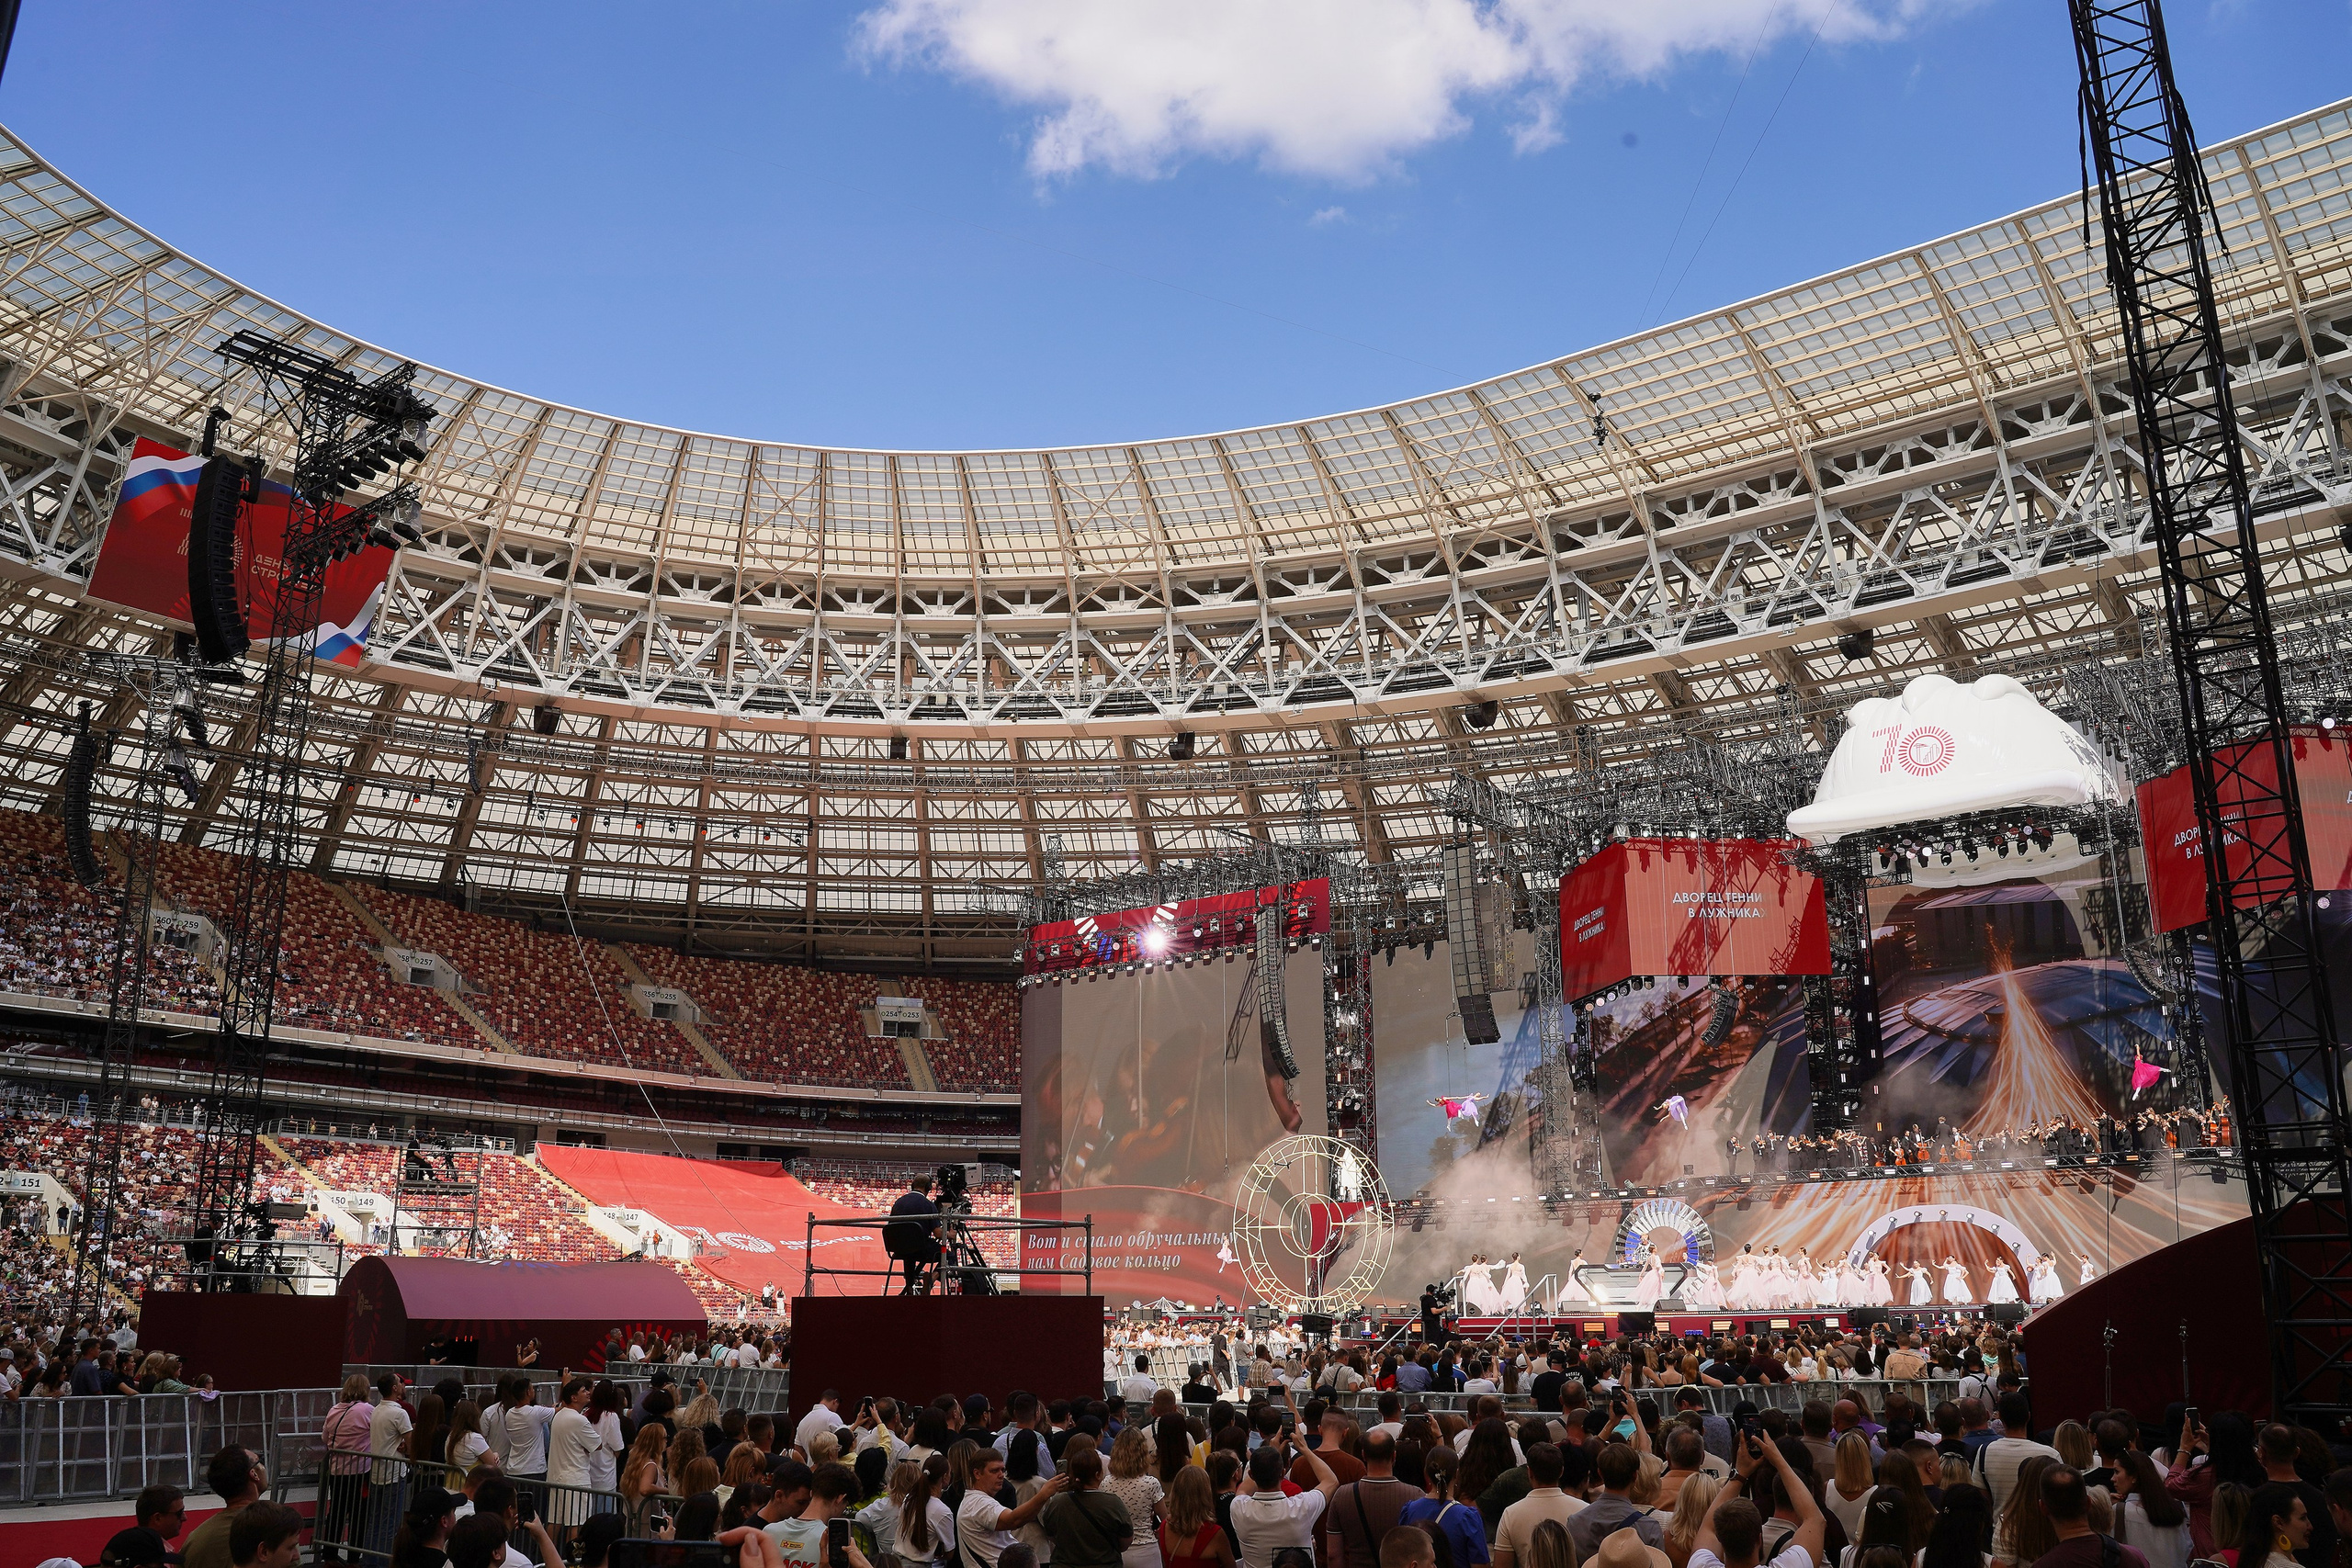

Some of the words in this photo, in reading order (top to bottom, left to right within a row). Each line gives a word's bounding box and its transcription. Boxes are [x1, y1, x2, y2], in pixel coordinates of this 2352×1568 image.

[2186, 848, 2192, 859] В
[1672, 892, 1724, 904] ДВОРЕЦ
[1688, 908, 1696, 918] В
[184, 919, 198, 930] 259
[1574, 912, 1591, 931] ДВОРЕЦ
[1578, 933, 1583, 942] В
[420, 958, 433, 966] 257
[643, 990, 656, 998] 256
[21, 1178, 40, 1188] 151
[358, 1198, 375, 1206] 149
[1028, 1234, 1057, 1249] Вот
[1061, 1236, 1070, 1248] и
[1074, 1235, 1123, 1248] стало
[1027, 1257, 1055, 1269] нам
[1059, 1252, 1120, 1269] Садовое
[1125, 1254, 1181, 1271] кольцо
